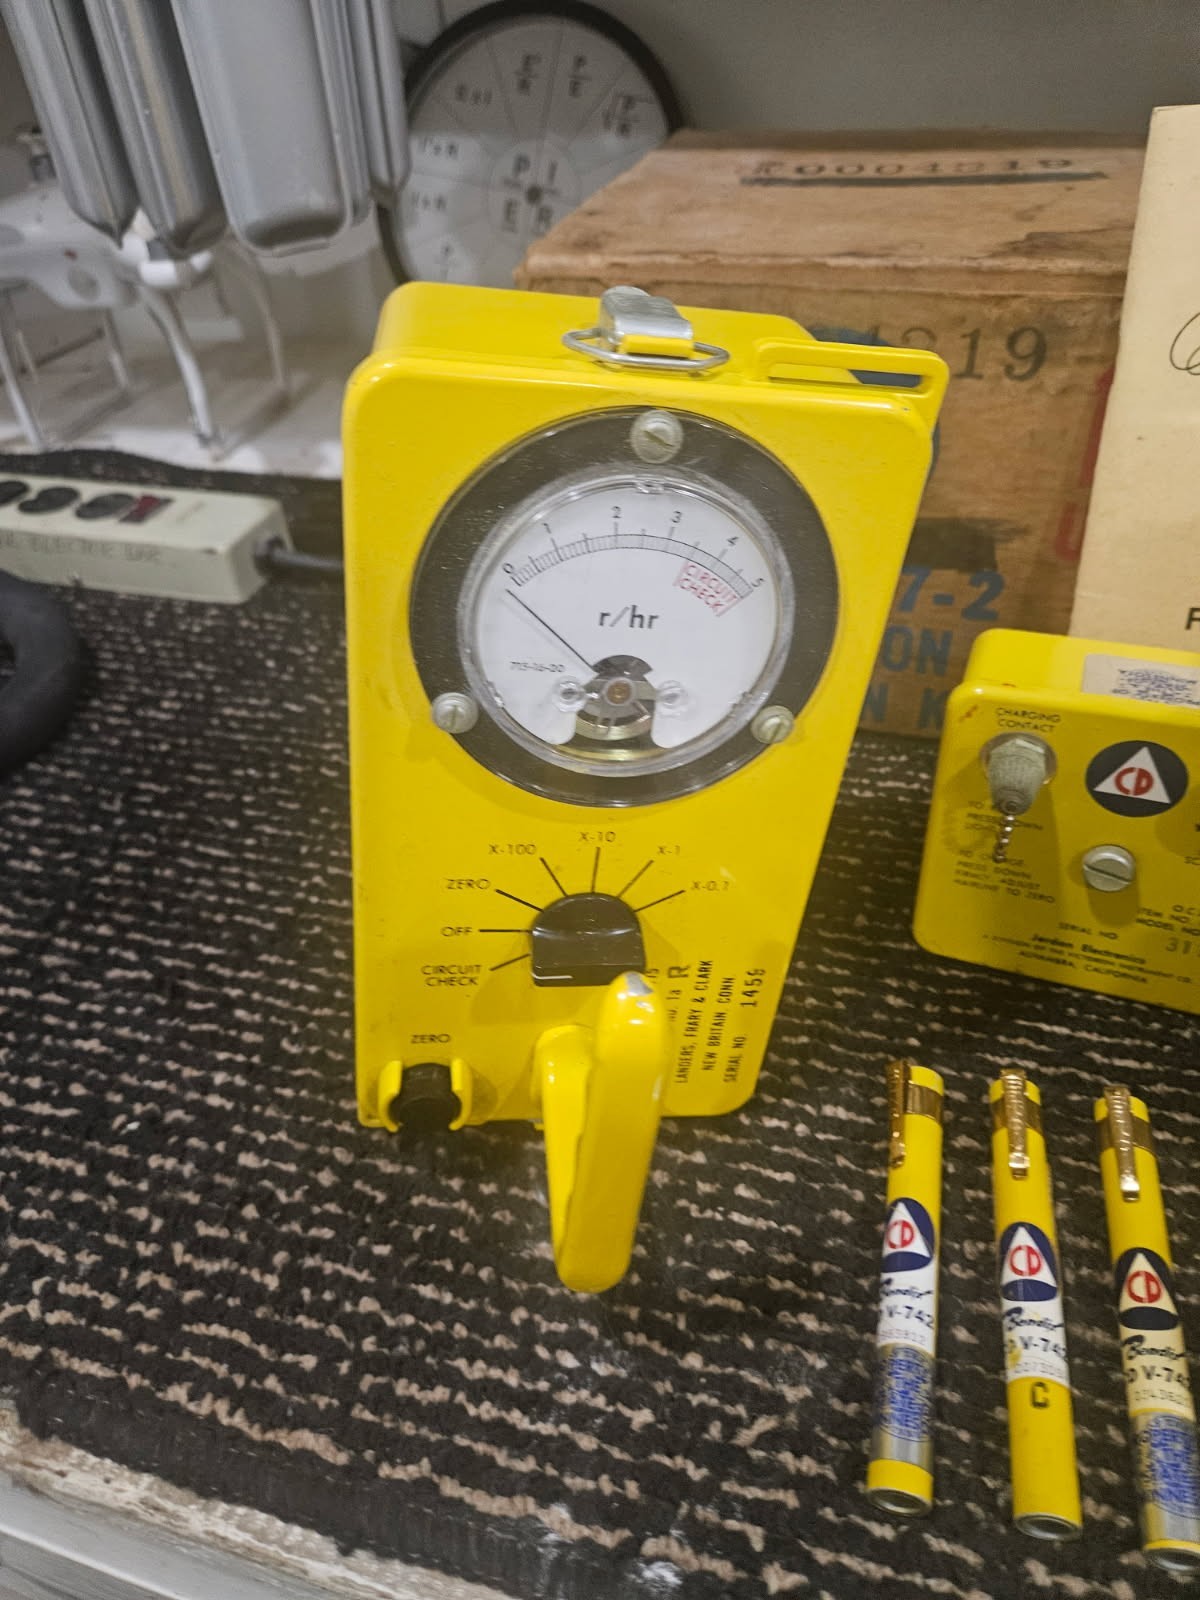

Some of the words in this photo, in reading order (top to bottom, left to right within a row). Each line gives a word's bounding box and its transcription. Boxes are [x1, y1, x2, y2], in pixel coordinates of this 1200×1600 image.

[502, 562, 514, 574] 0
[543, 523, 552, 534] 1
[611, 506, 622, 519] 2
[672, 511, 683, 523] 3
[726, 536, 739, 547] 4
[751, 577, 765, 588] 5
[679, 578, 724, 609] CHECK
[599, 605, 659, 629] r/hr
[996, 707, 1061, 723] CHARGING
[998, 719, 1055, 732] CONTACT
[579, 831, 617, 843] X-10
[489, 844, 537, 855] X-100
[657, 845, 681, 856] X-1
[446, 878, 491, 890] ZERO
[441, 926, 473, 938] OFF
[1058, 921, 1093, 936] SERIAL
[1136, 917, 1175, 932] MODEL
[421, 964, 482, 976] CIRCUIT
[426, 976, 479, 987] CHECK
[683, 1009, 703, 1038] FRARY
[694, 960, 713, 991] CLARK
[411, 1033, 451, 1045] ZERO
[702, 1052, 718, 1071] NEW
[723, 1054, 744, 1083] SERIAL
[1031, 1381, 1048, 1409] C
